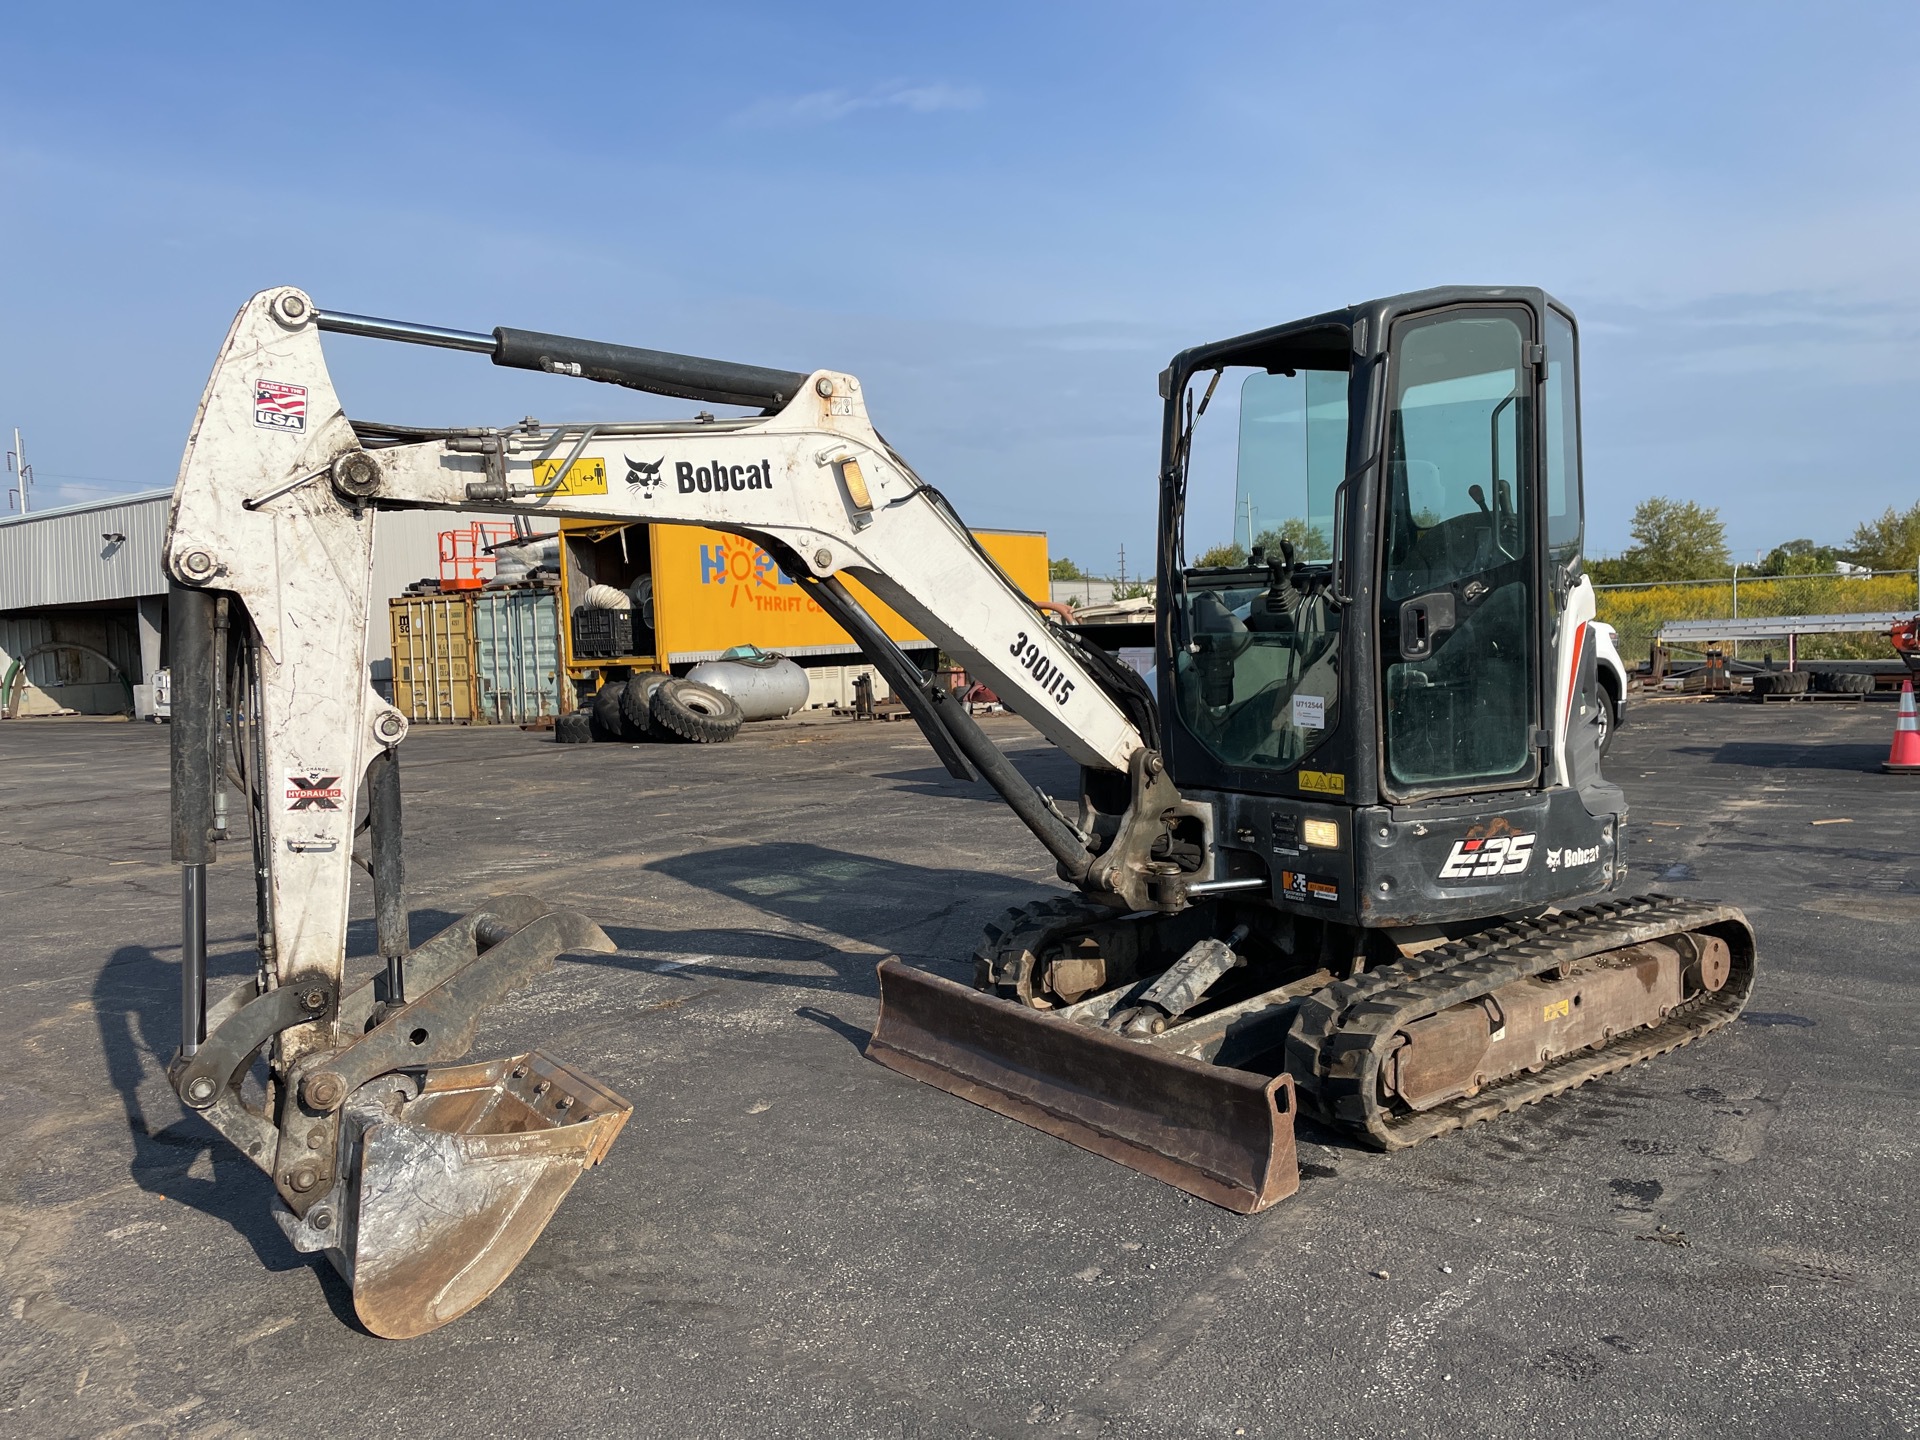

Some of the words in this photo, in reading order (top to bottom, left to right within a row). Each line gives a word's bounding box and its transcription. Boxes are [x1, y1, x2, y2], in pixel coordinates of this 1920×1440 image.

[260, 382, 279, 391] MADE
[257, 411, 301, 428] USA
[675, 459, 773, 494] Bobcat
[755, 595, 802, 613] THRIFT
[1010, 632, 1075, 705] 390115
[1295, 701, 1323, 710] U712544
[288, 790, 339, 798] HYDRAULIC
[1439, 834, 1537, 879] E35
[1564, 845, 1600, 869] Bobcat
[1283, 871, 1307, 892] H&E
